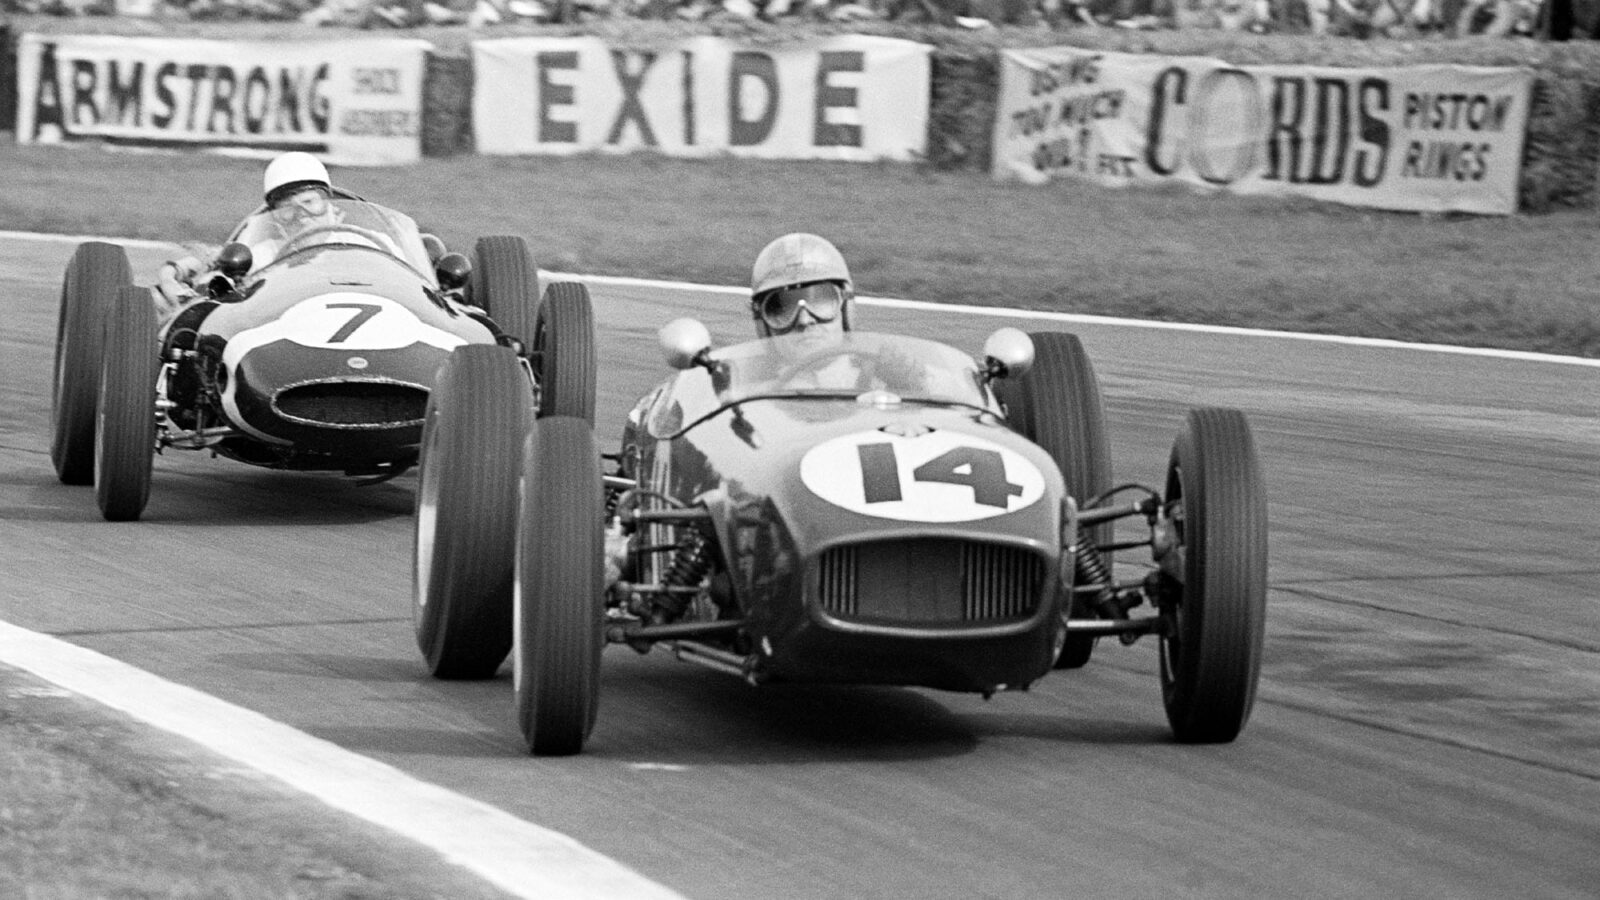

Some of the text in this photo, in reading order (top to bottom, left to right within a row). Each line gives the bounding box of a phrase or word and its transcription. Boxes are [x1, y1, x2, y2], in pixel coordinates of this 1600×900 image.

[34, 43, 331, 140] ARMSTRONG
[537, 50, 865, 147] EXIDE
[1402, 92, 1513, 132] PISTON
[1146, 66, 1390, 188] CORDS
[1400, 140, 1491, 181] RINGS
[326, 303, 382, 343] 7
[857, 442, 1023, 509] 14
